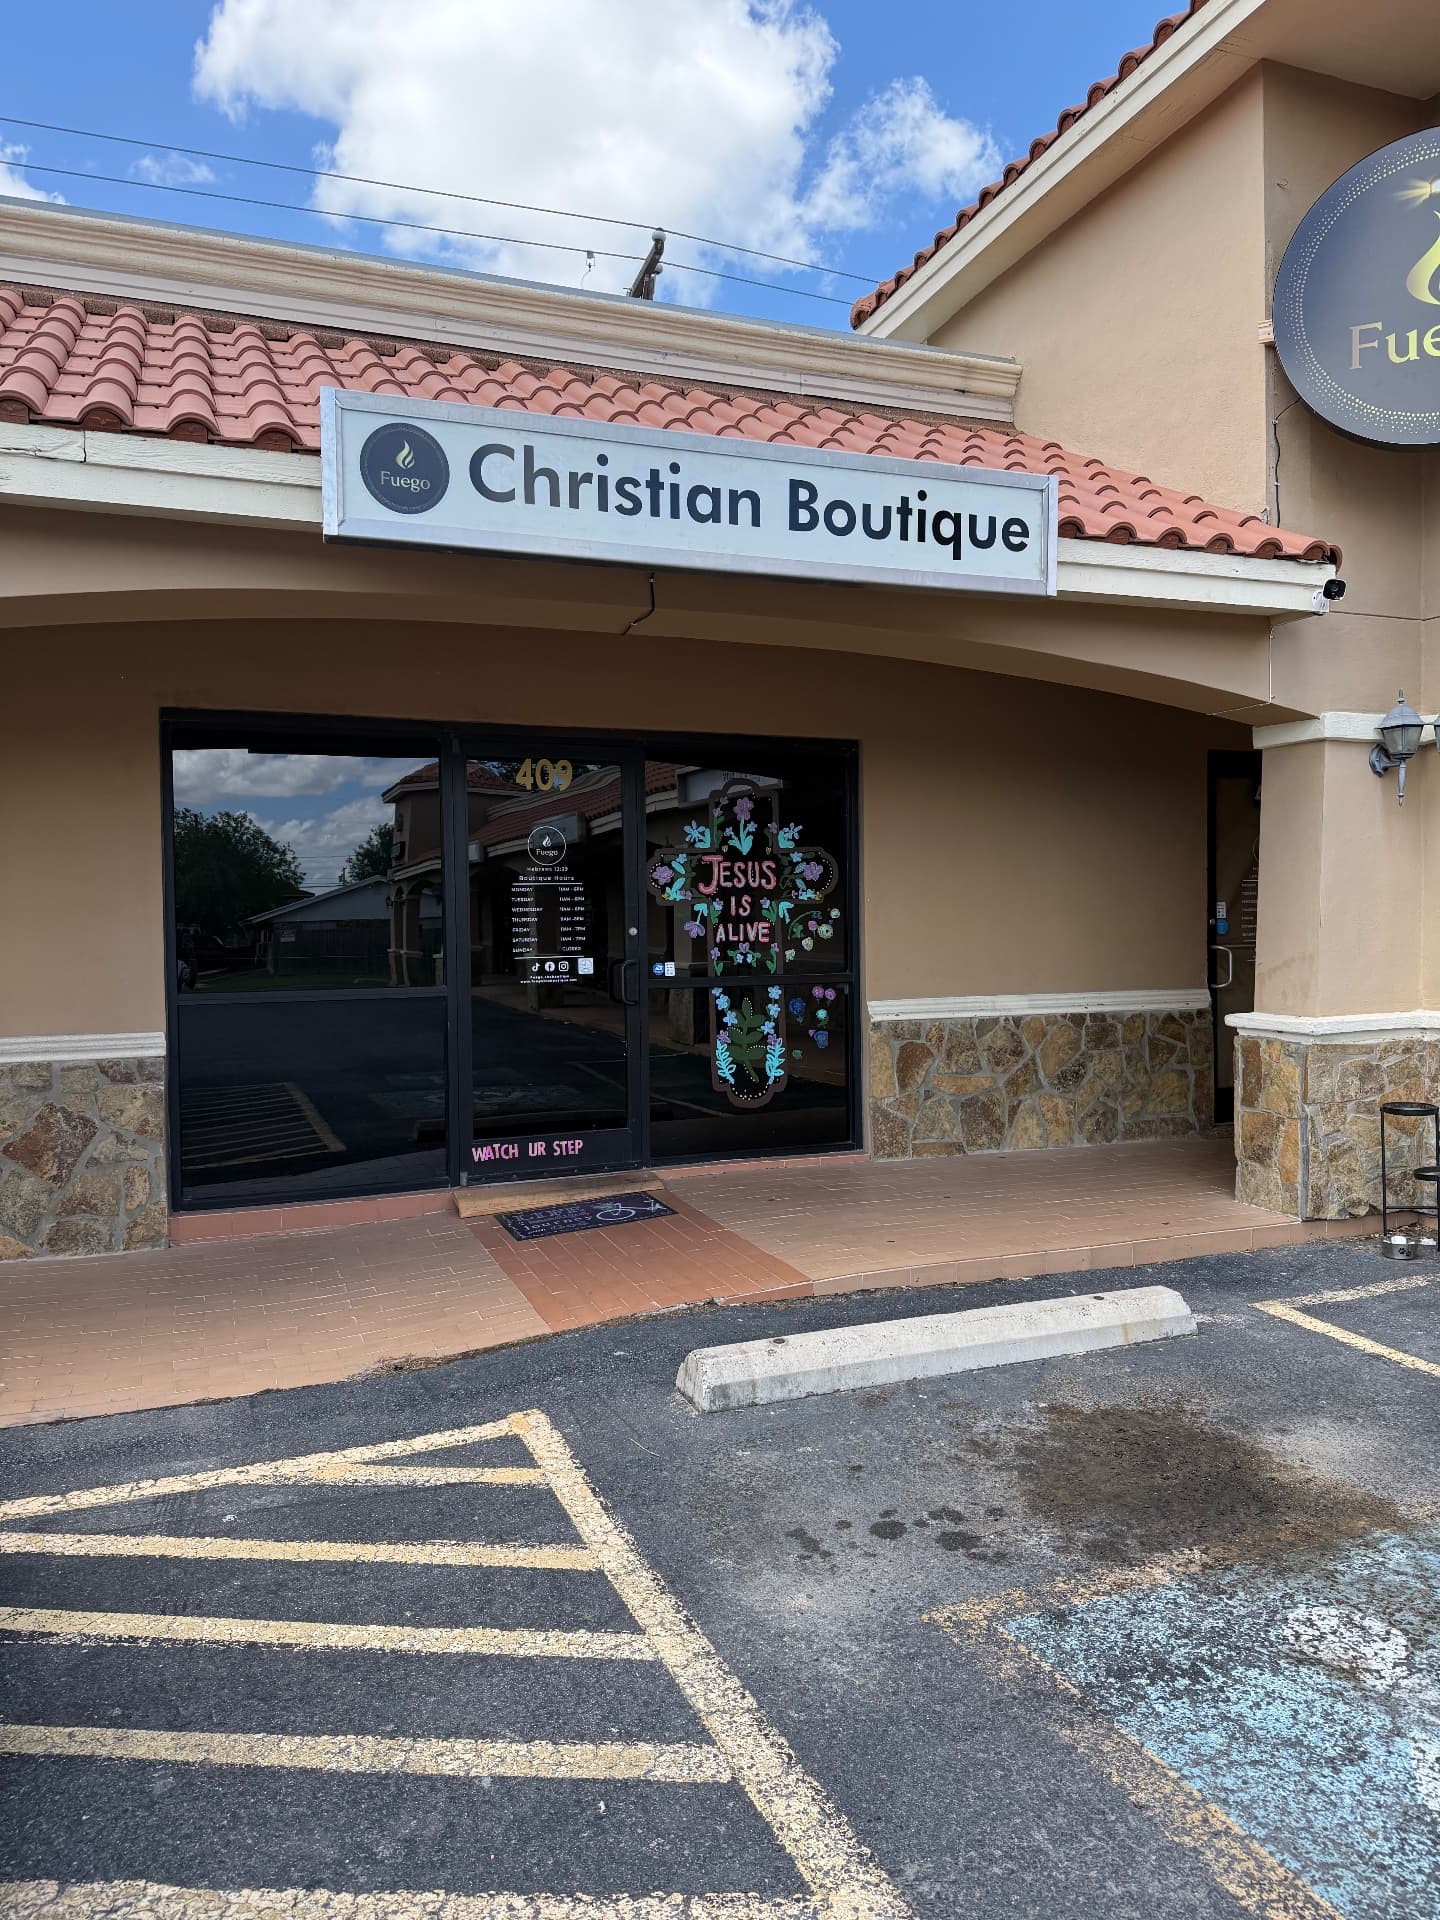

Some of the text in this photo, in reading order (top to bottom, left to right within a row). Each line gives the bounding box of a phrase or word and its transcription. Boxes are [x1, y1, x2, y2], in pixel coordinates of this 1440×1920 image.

[378, 470, 431, 493] Fuego
[467, 442, 1030, 560] Christian Boutique
[515, 758, 573, 791] 409
[535, 848, 559, 857] Fuego
[698, 854, 777, 894] JESUS
[730, 895, 751, 917] IS
[716, 921, 770, 943] ALIVE
[472, 1139, 584, 1162] WATCH UR STEP
